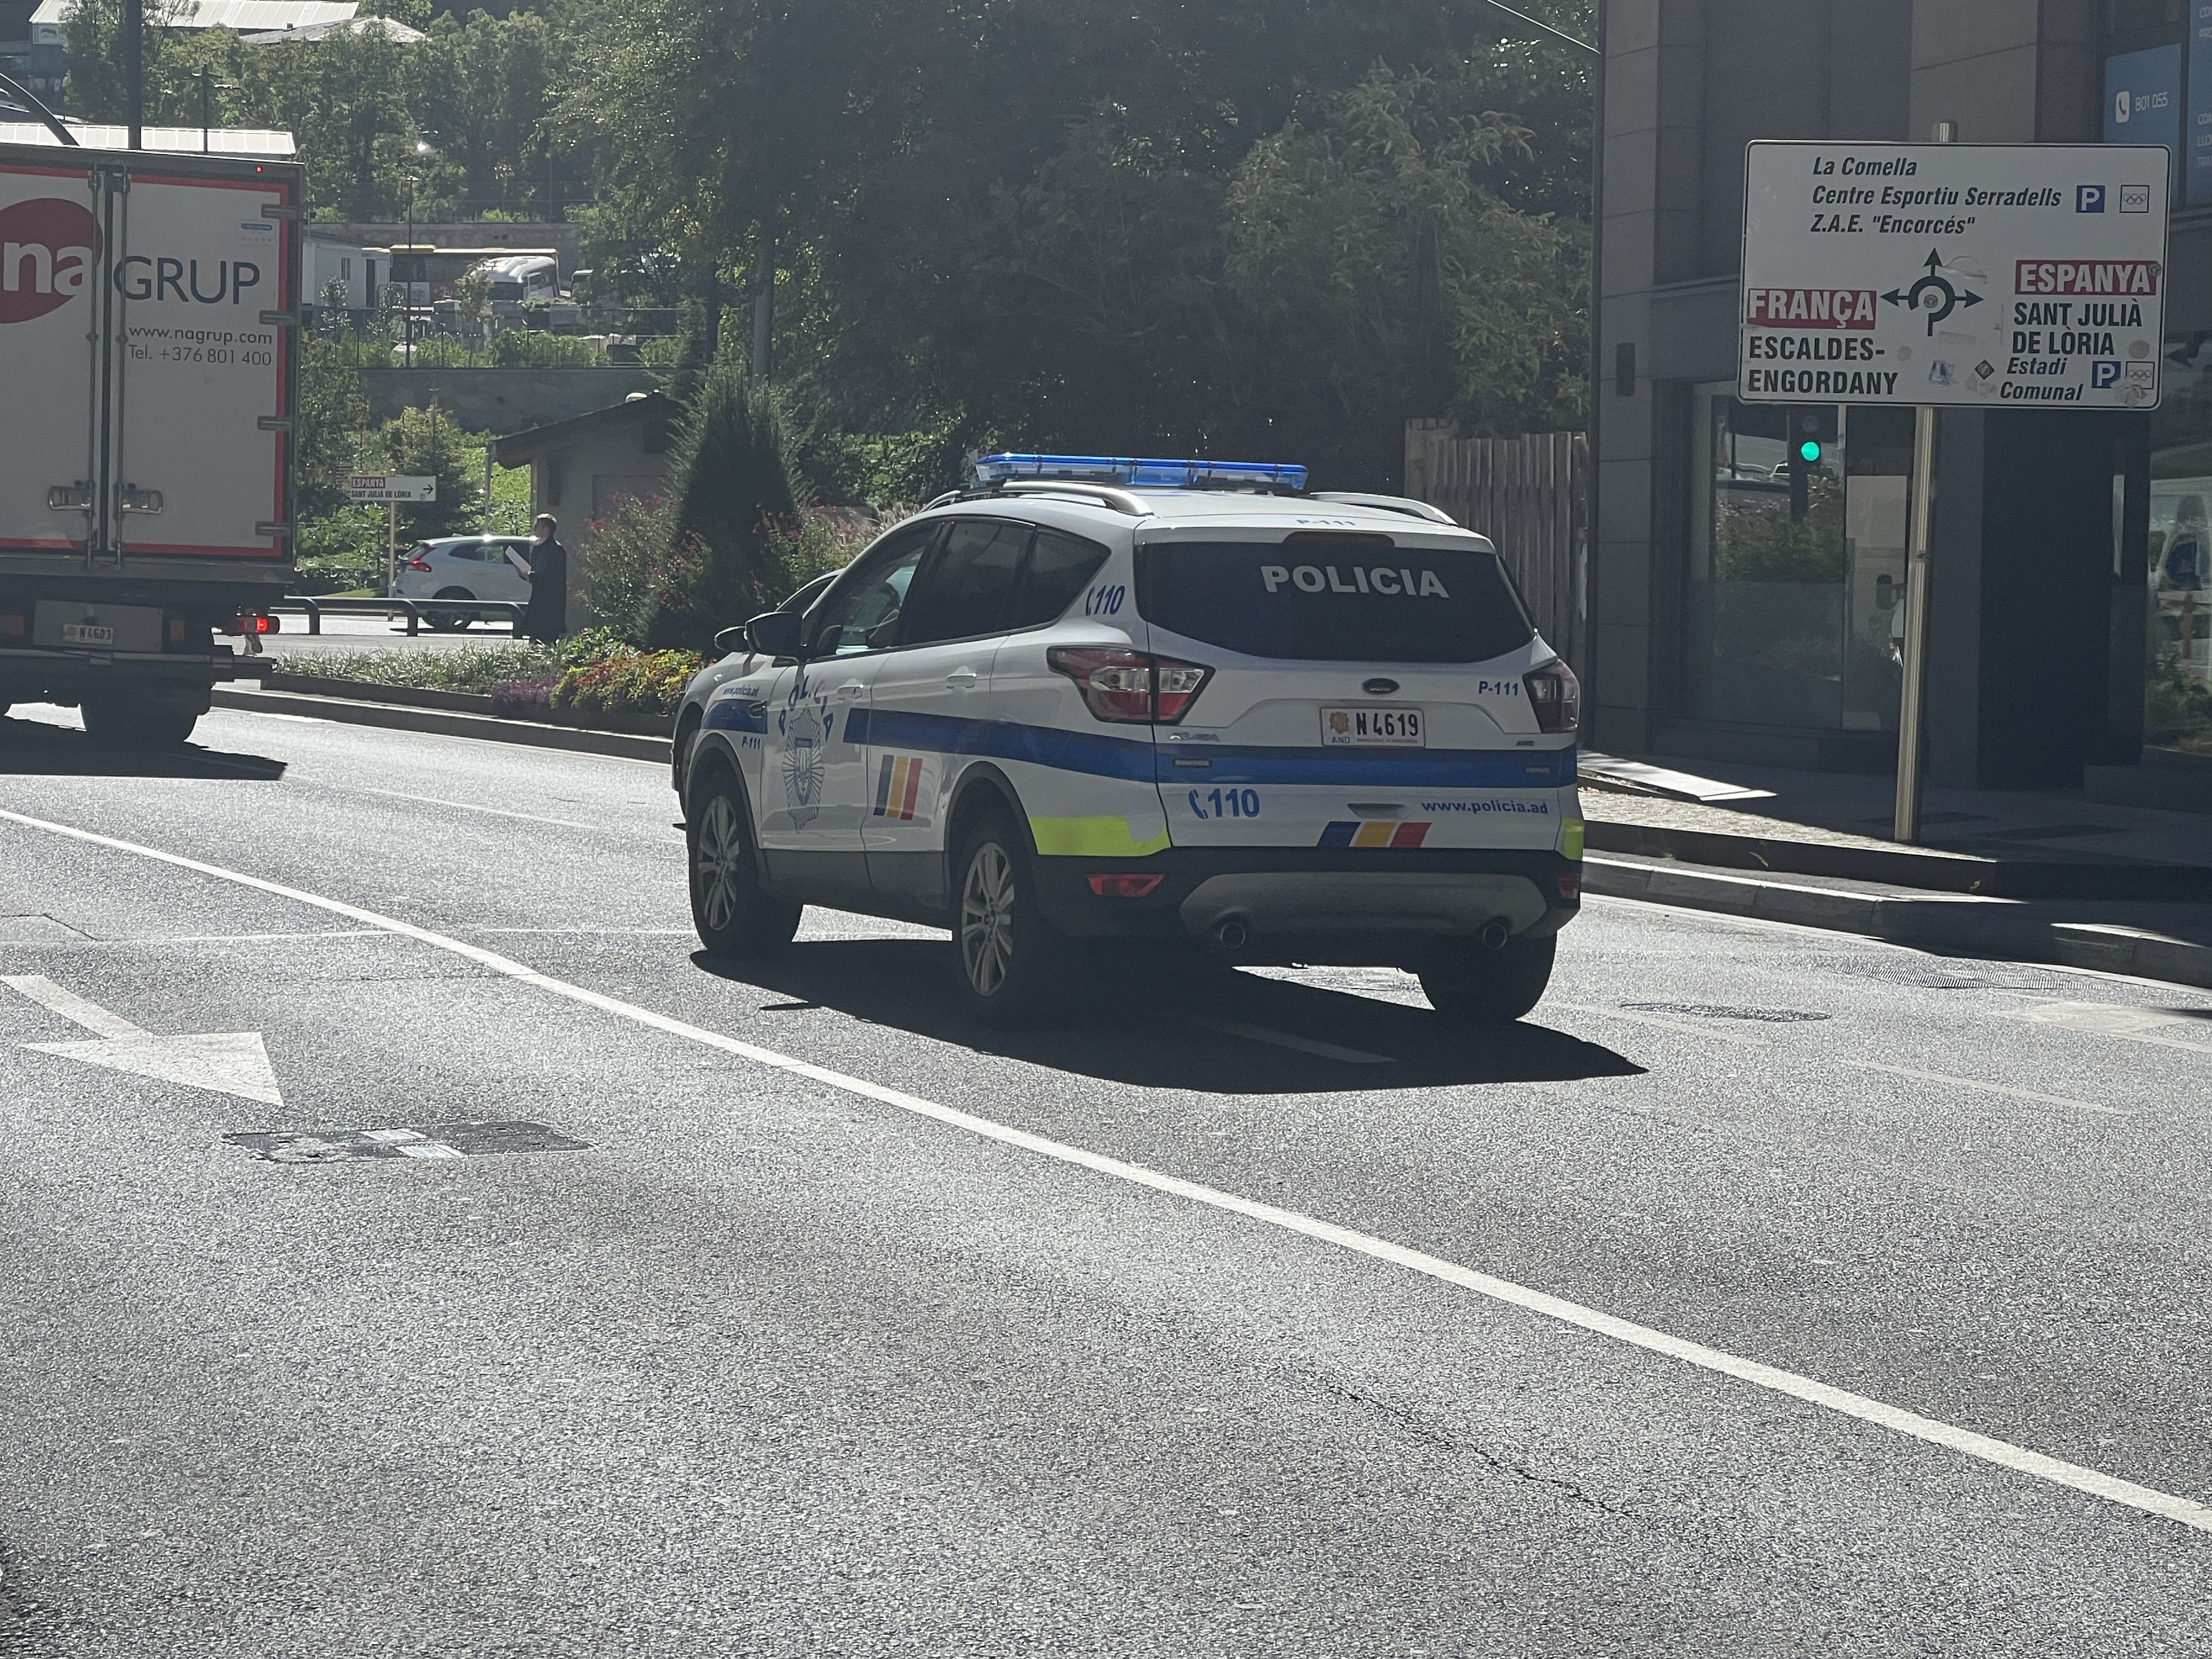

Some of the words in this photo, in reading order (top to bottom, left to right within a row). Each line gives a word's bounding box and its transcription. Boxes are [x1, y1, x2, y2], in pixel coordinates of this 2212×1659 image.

[2135, 95, 2149, 111] 801
[2152, 92, 2168, 109] 055
[1813, 157, 1835, 175] La
[1841, 157, 1917, 176] Comella
[1813, 185, 1875, 205] Centre
[1881, 186, 1959, 208] Esportiu
[1965, 187, 2062, 207] Serradells
[1810, 214, 1864, 233] Z.A.E.
[1872, 215, 1976, 234] "Encorcés"
[113, 255, 260, 304] GRUP
[2020, 263, 2151, 293] ESPANYA
[1748, 290, 1874, 329] FRANÇA
[2014, 302, 2072, 326] SANT
[2078, 298, 2142, 327] JULIÀ
[129, 327, 272, 345] www.nagrup.com
[2012, 331, 2041, 354] DE
[2049, 326, 2114, 356] LÒRIA
[128, 345, 153, 360] Tel.
[159, 347, 202, 362] +376
[207, 348, 235, 364] 801
[242, 351, 272, 366] 400
[1749, 336, 1885, 360] ESCALDES-
[2007, 357, 2068, 375] Estadi
[1748, 369, 1898, 394] ENGORDANY
[2000, 381, 2084, 401] Comunal
[352, 478, 384, 488] ESPANYA
[1261, 565, 1450, 599] POLICIA
[1094, 585, 1125, 615] 110
[1479, 681, 1519, 696] P-111
[1356, 713, 1367, 735] N
[1373, 713, 1419, 736] 4619
[742, 735, 760, 750] P-111
[1208, 788, 1260, 817] 110
[1421, 800, 1548, 814] www.policia.ad
